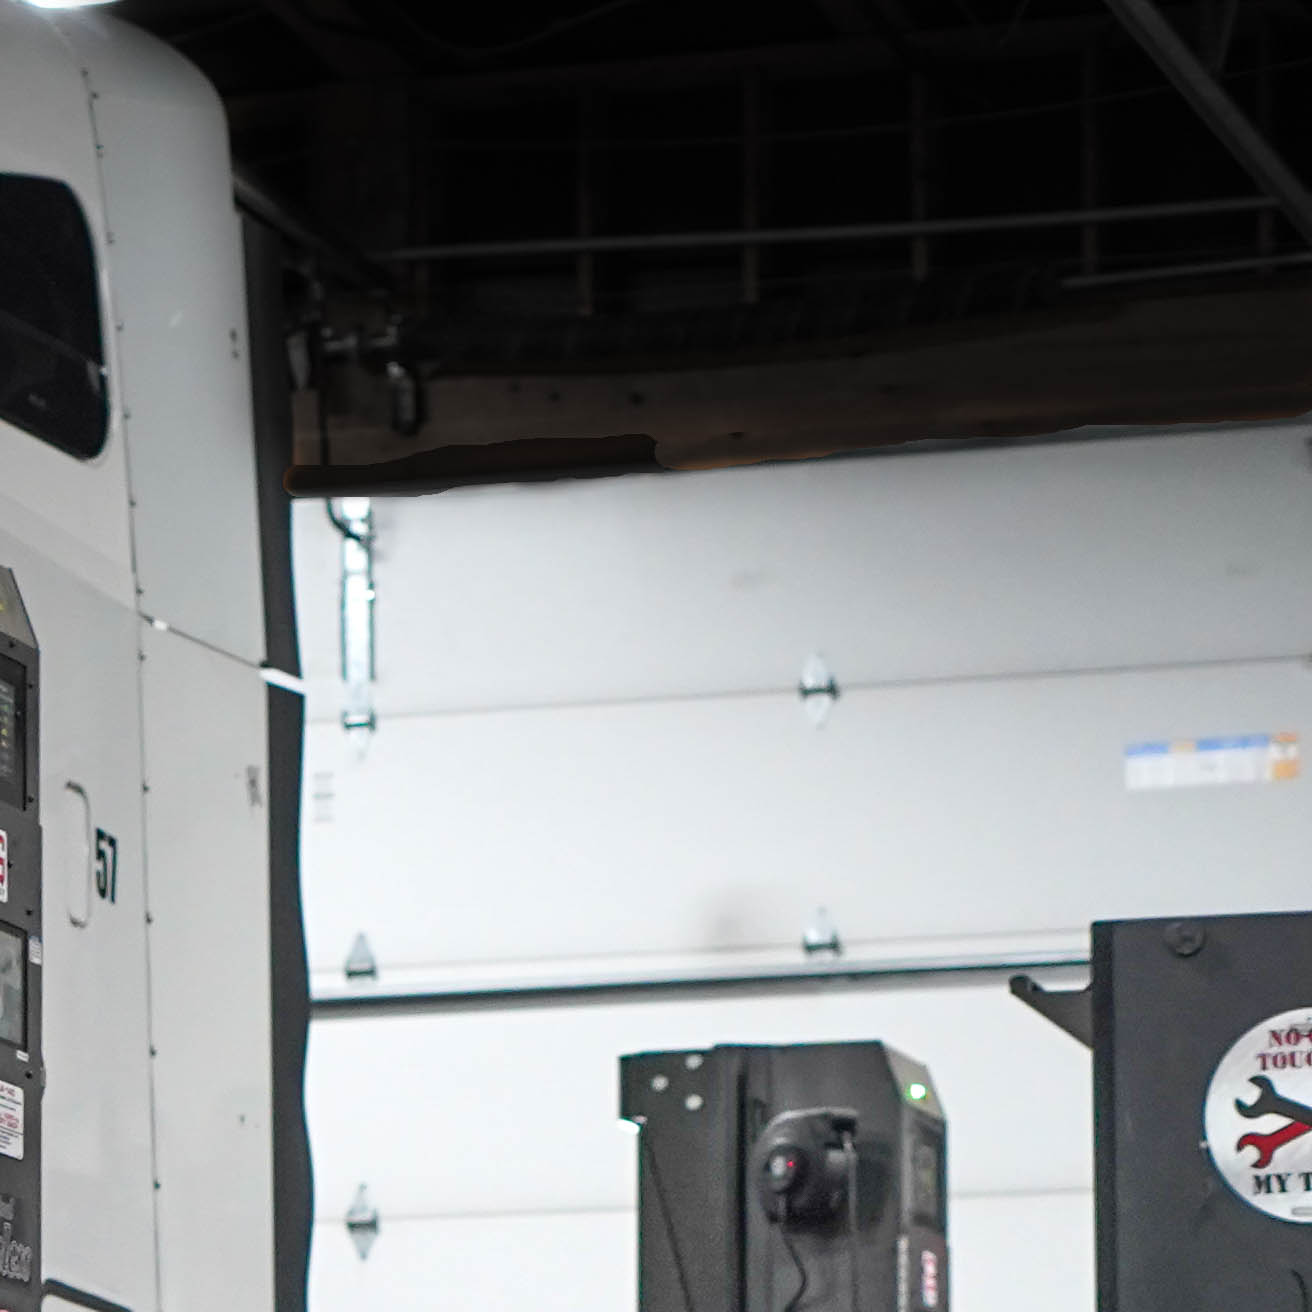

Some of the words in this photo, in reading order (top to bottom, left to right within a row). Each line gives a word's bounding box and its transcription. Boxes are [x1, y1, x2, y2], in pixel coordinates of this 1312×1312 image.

[96, 828, 117, 904] 57
[1268, 1028, 1301, 1048] NO
[1252, 1172, 1292, 1194] MY
